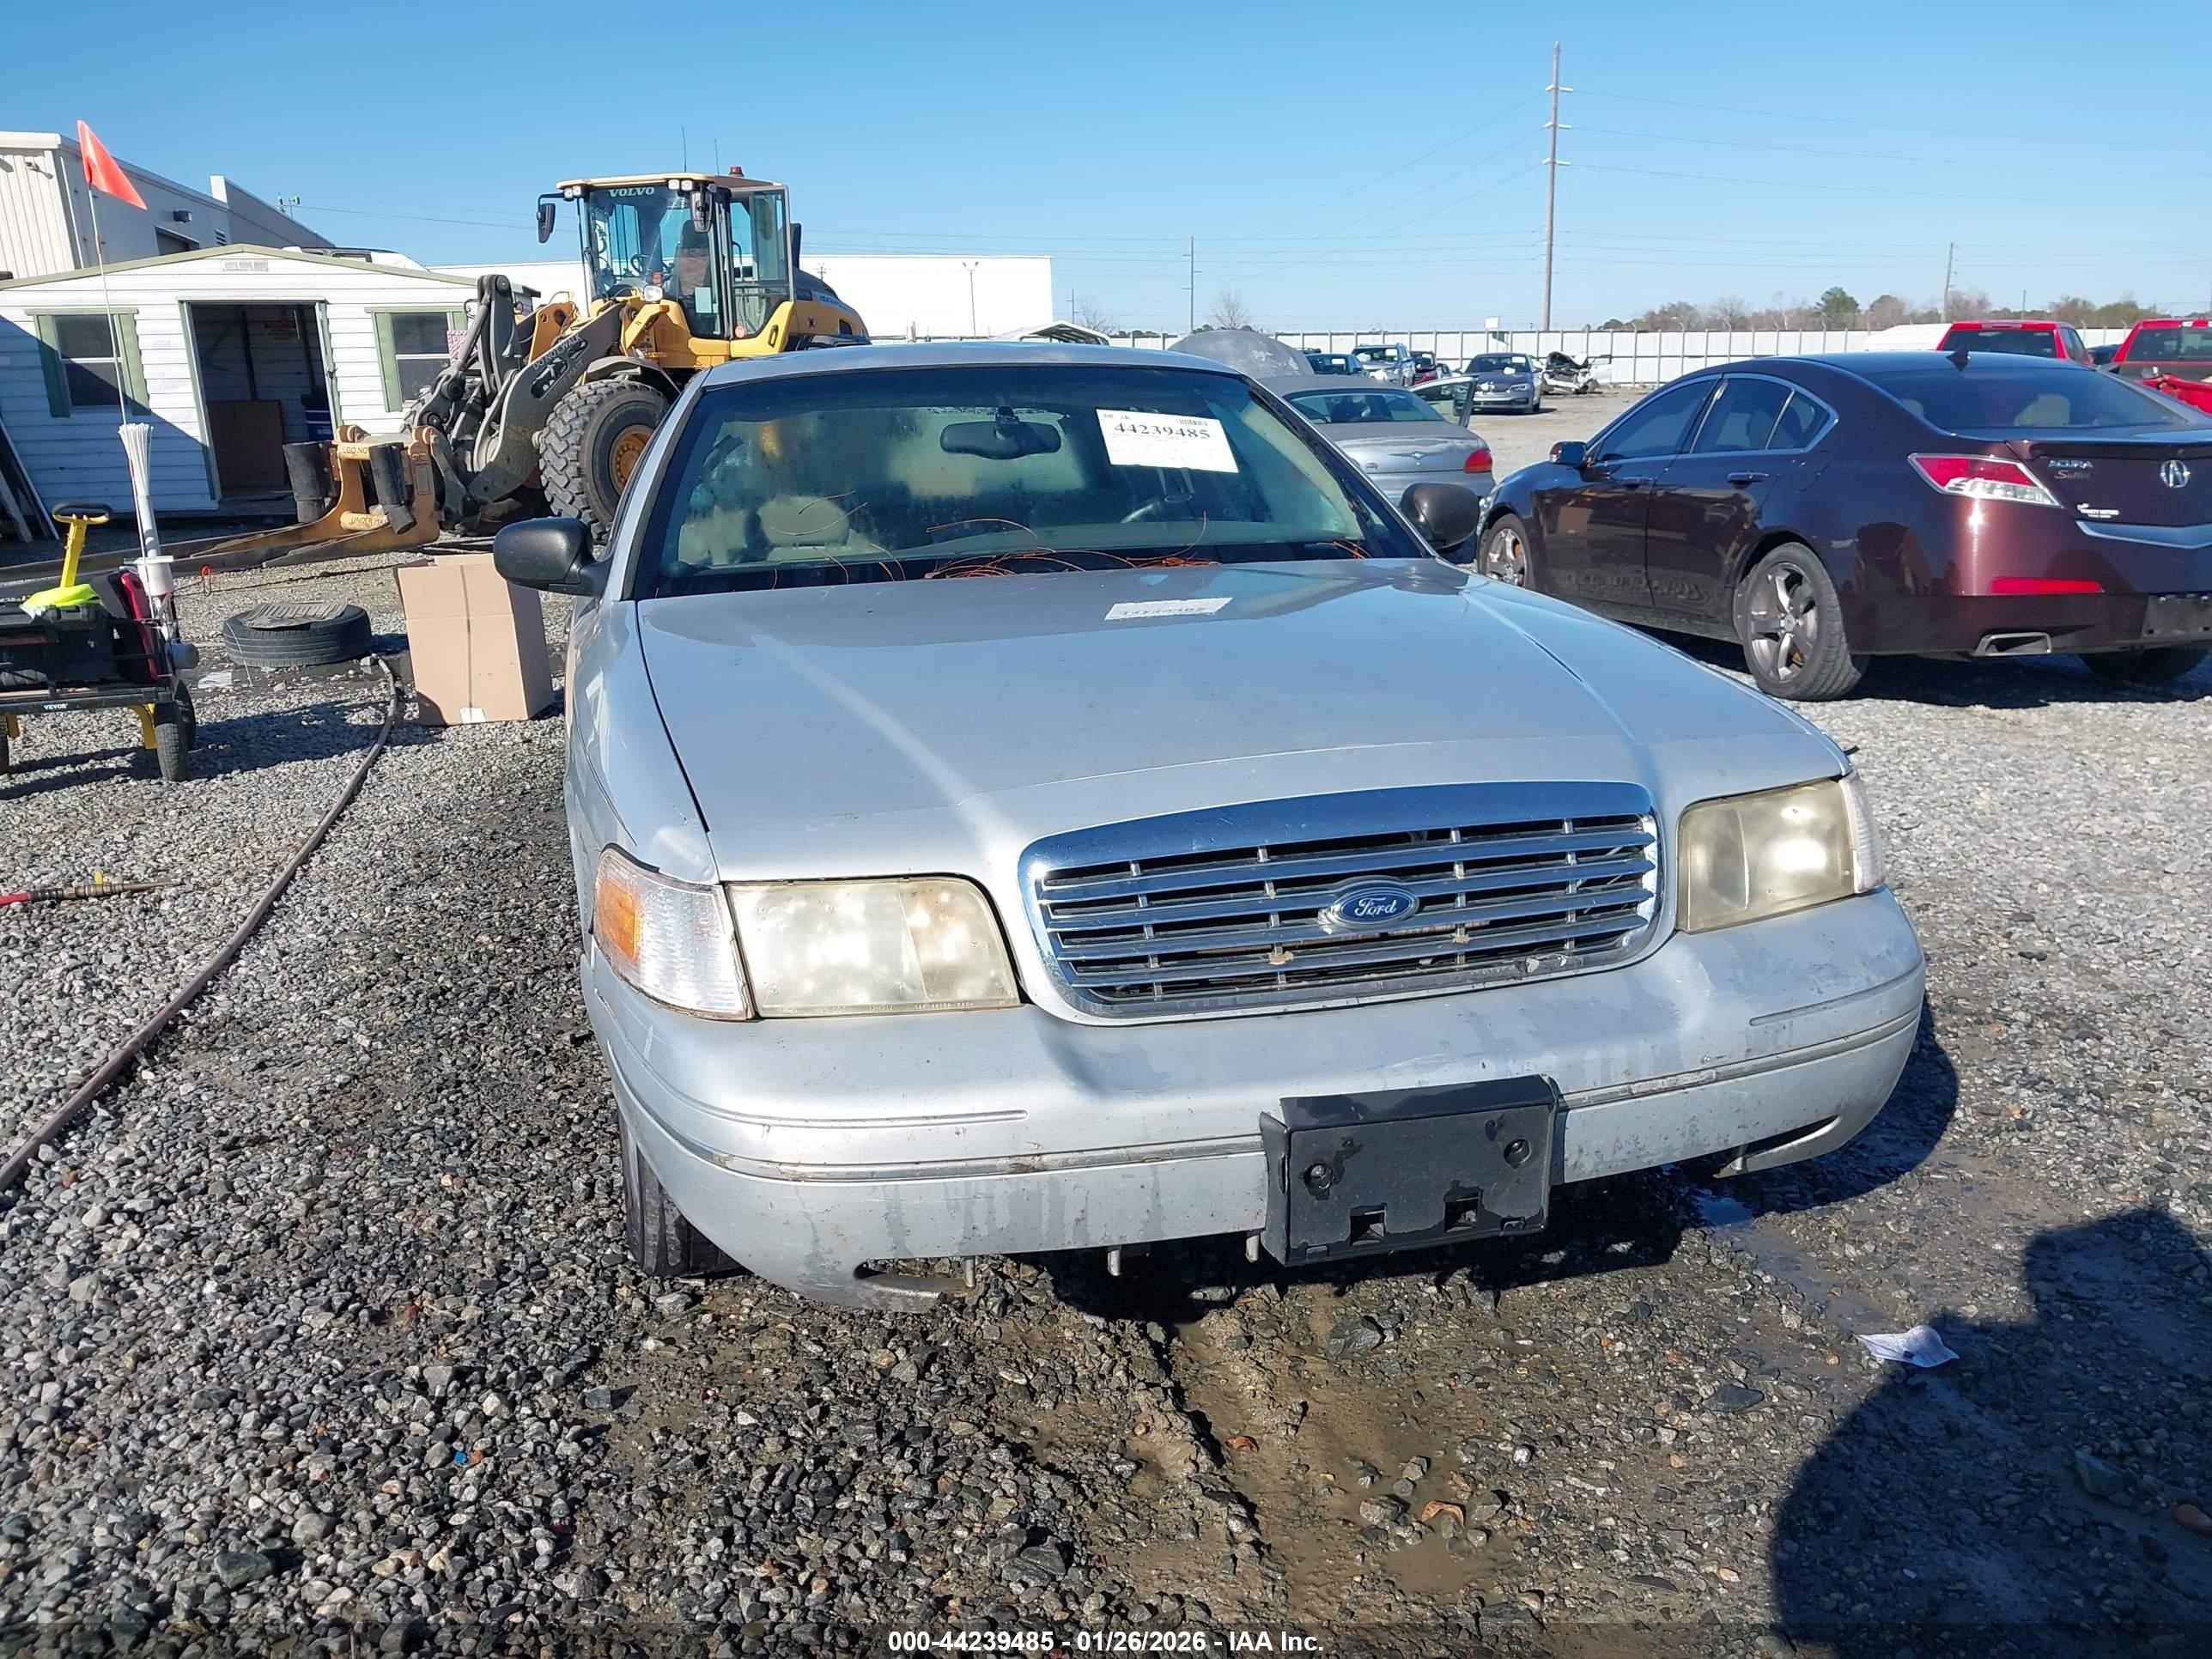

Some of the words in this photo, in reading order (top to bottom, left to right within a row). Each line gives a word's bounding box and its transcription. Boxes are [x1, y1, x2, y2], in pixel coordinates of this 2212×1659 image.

[608, 186, 654, 198] VOLVO
[532, 360, 544, 370] DO
[561, 334, 583, 353] WALK
[1114, 422, 1211, 440] 44239485
[2048, 459, 2094, 469] ACURA
[1353, 896, 1398, 917] Ford
